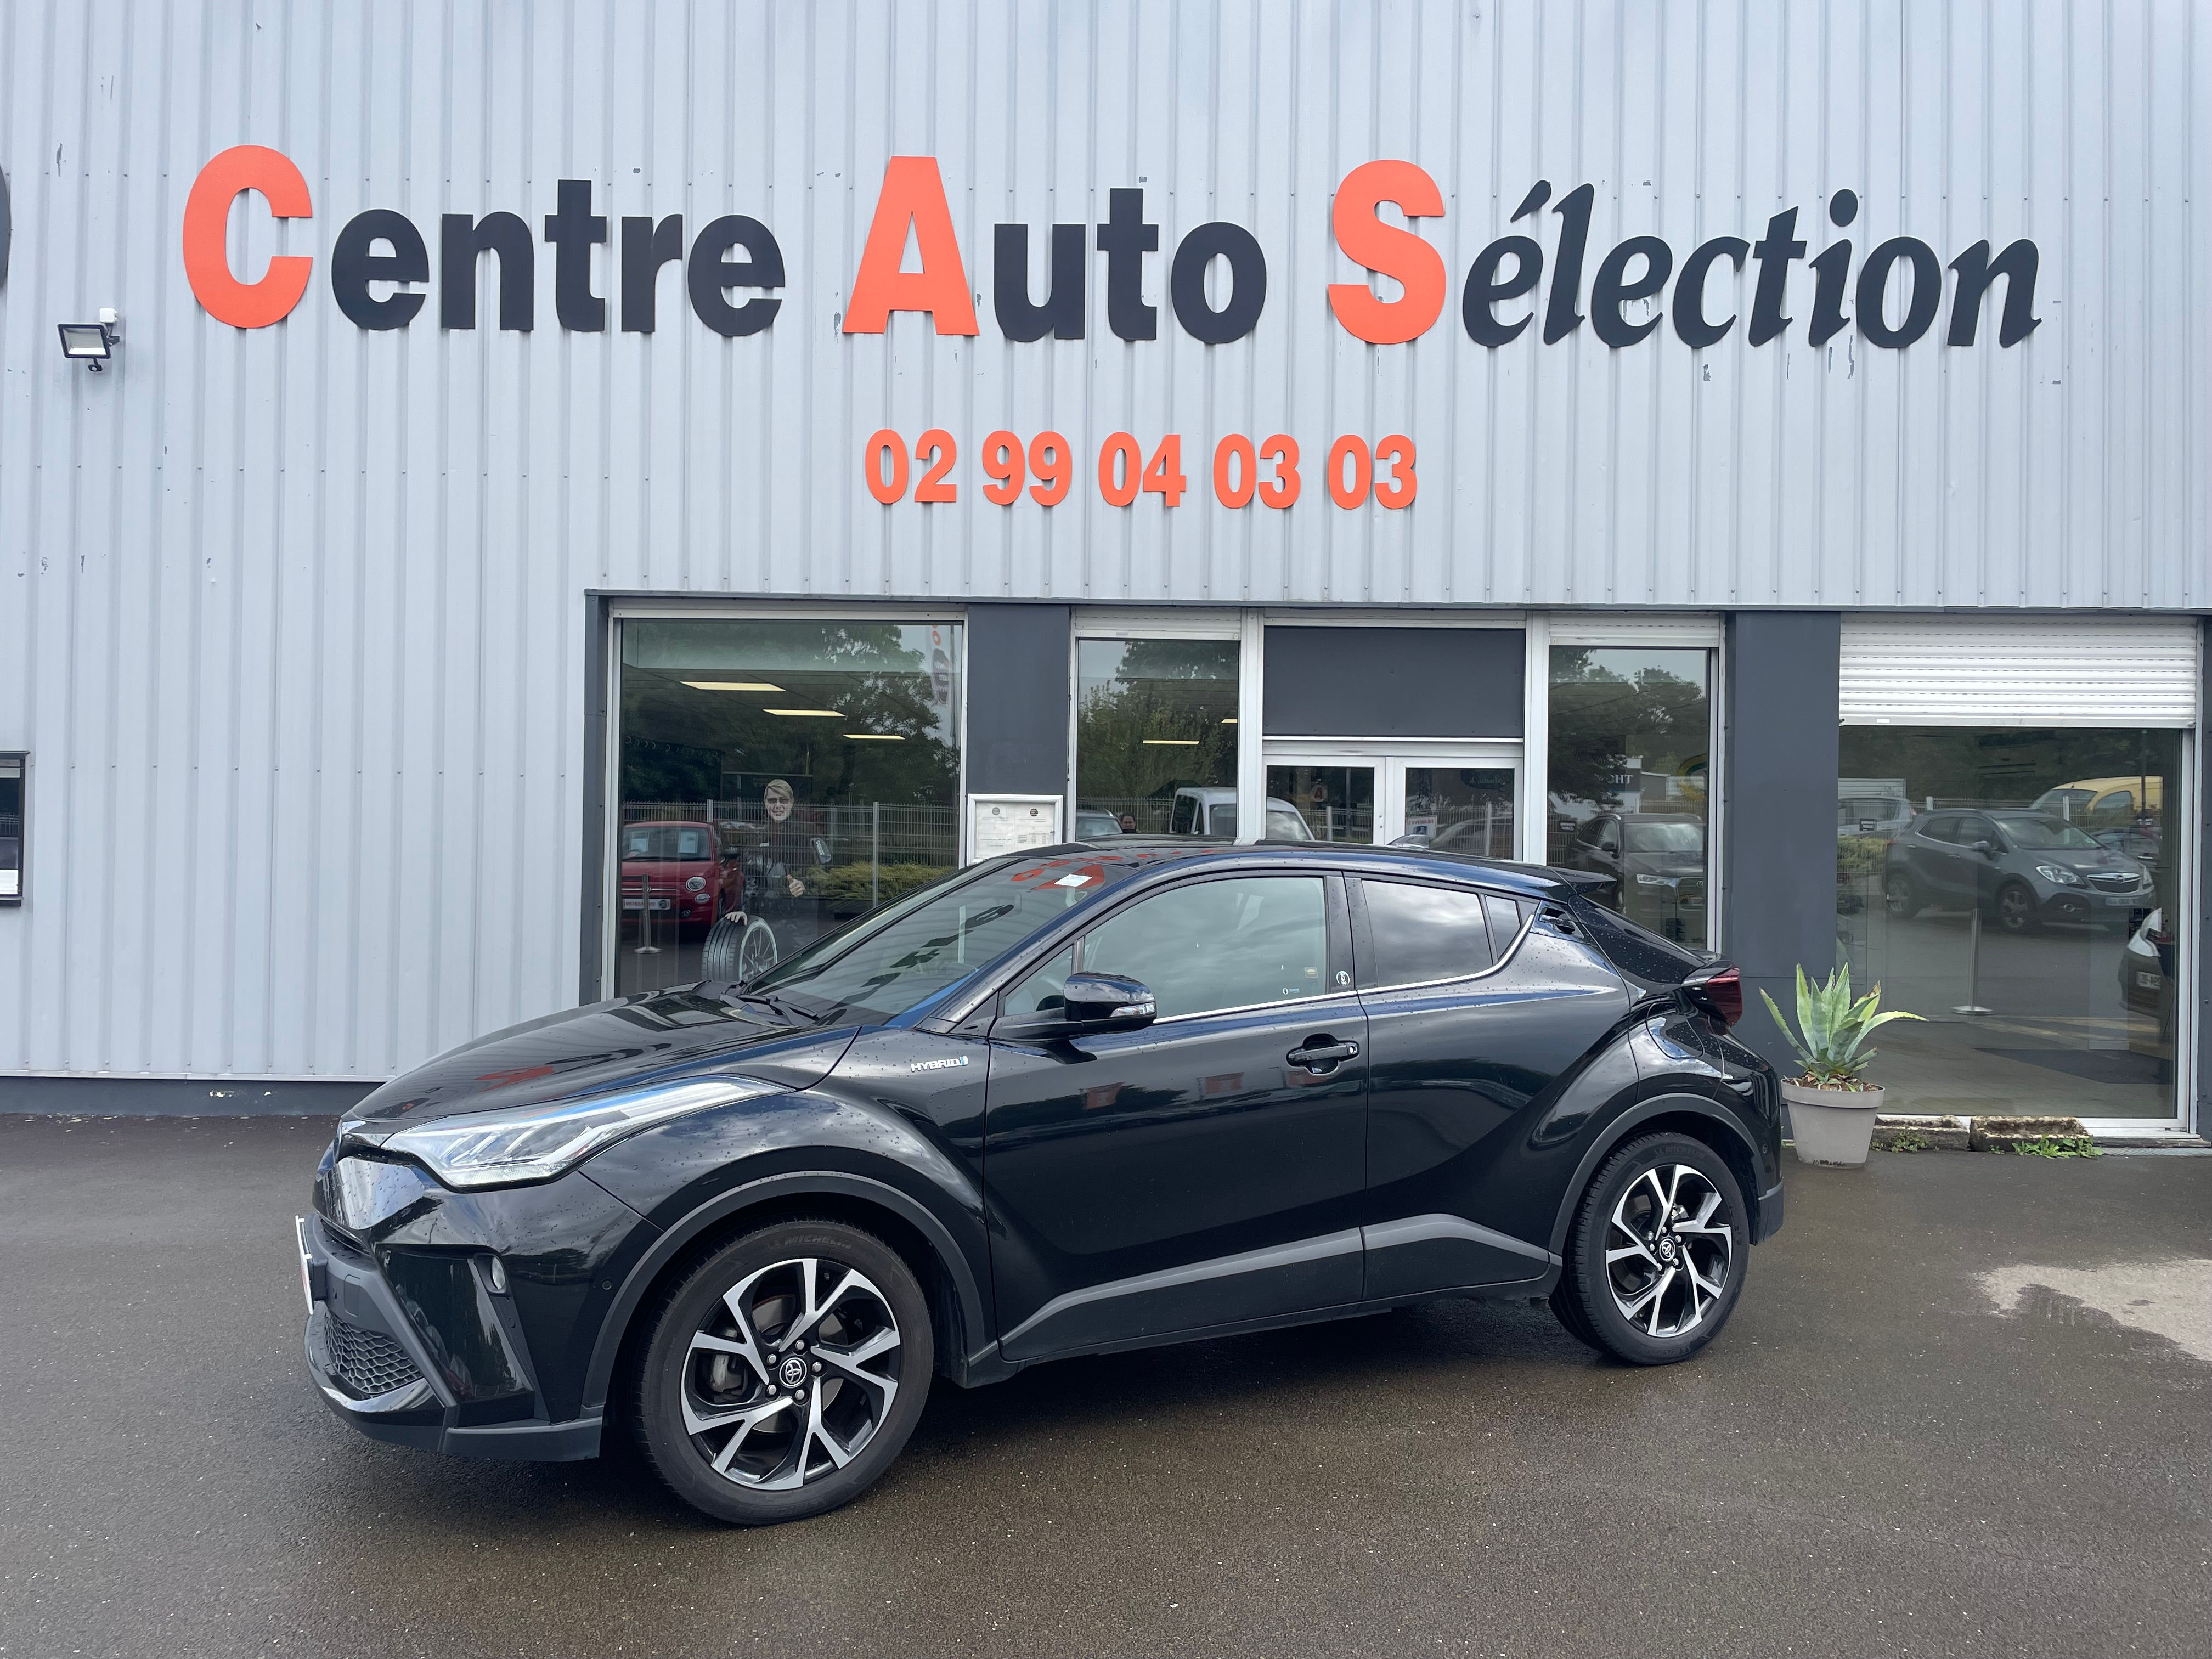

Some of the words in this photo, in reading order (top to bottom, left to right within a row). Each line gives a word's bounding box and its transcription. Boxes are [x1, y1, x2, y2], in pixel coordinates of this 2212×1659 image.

[183, 145, 785, 338] Centre
[842, 156, 1267, 346] Auto
[1328, 160, 2042, 349] Sélection
[866, 429, 956, 506] 02
[983, 431, 1072, 508] 99
[1098, 432, 1186, 507] 04
[1214, 434, 1301, 510] 03
[1328, 434, 1417, 510] 03
[910, 1058, 961, 1071] HYBRID
[785, 1234, 853, 1249] MICHELIN
